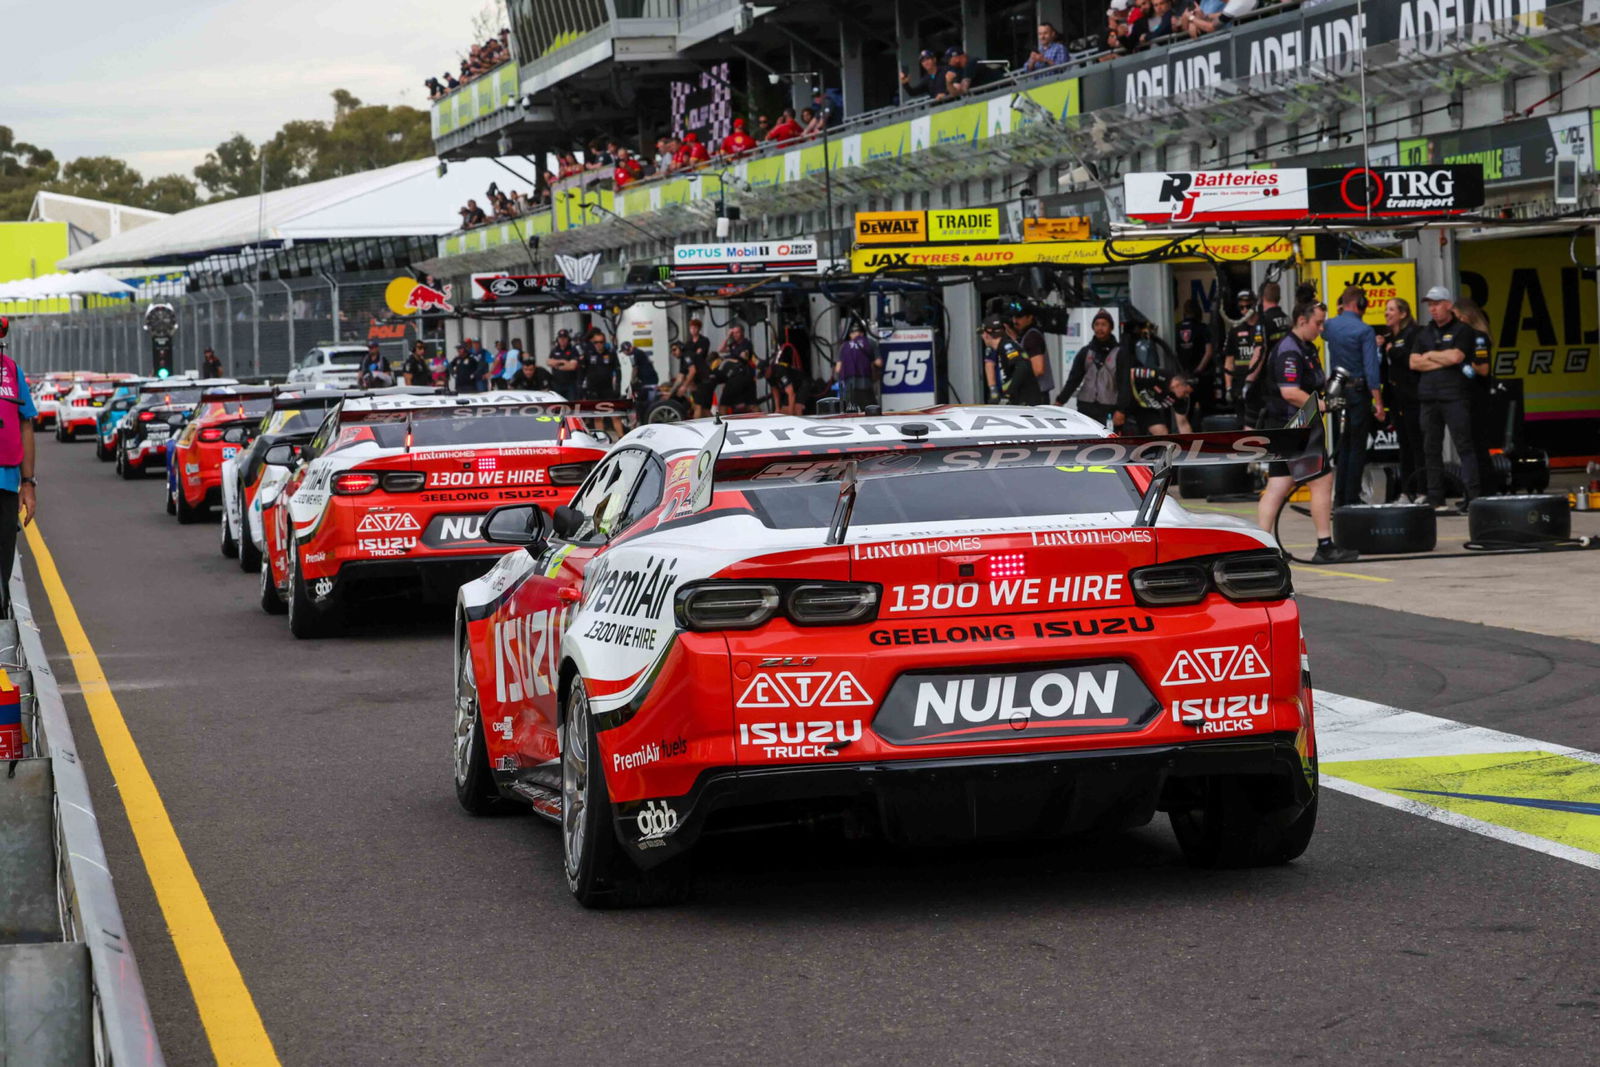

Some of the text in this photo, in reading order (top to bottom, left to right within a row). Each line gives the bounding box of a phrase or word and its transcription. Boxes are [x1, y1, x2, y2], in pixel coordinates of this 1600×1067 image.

[1249, 13, 1367, 92] ADELAIDE
[1125, 51, 1221, 112] ADELAIDE
[1194, 171, 1278, 187] Batteries
[1384, 170, 1455, 197] TRG
[1387, 197, 1454, 210] transport
[936, 214, 992, 229] TRADIE
[678, 247, 721, 259] OPTUS
[727, 246, 757, 257] Mobil
[864, 253, 910, 267] JAX
[911, 254, 960, 265] TYRES
[963, 255, 970, 263] &
[974, 252, 1014, 263] AUTO
[1203, 245, 1249, 255] TYRES
[1264, 243, 1292, 253] AUT
[1344, 271, 1397, 291] JAX
[883, 349, 931, 387] 55
[727, 415, 1067, 447] PremiAir
[942, 435, 1271, 471] SPTOOLS
[430, 469, 545, 486] 1300 WE HIRE
[498, 490, 559, 499] ISUZU
[440, 518, 481, 540] NU
[358, 536, 417, 550] ISUZU
[890, 574, 1123, 612] 1300 WE HIRE
[584, 619, 657, 651] 1300 WE HIRE
[870, 616, 1155, 646] GEELONG ISUZU
[913, 669, 1120, 727] NULON
[1172, 693, 1270, 723] ISUZU
[739, 719, 862, 746] ISUZU
[613, 736, 688, 773] PremiAir fuels
